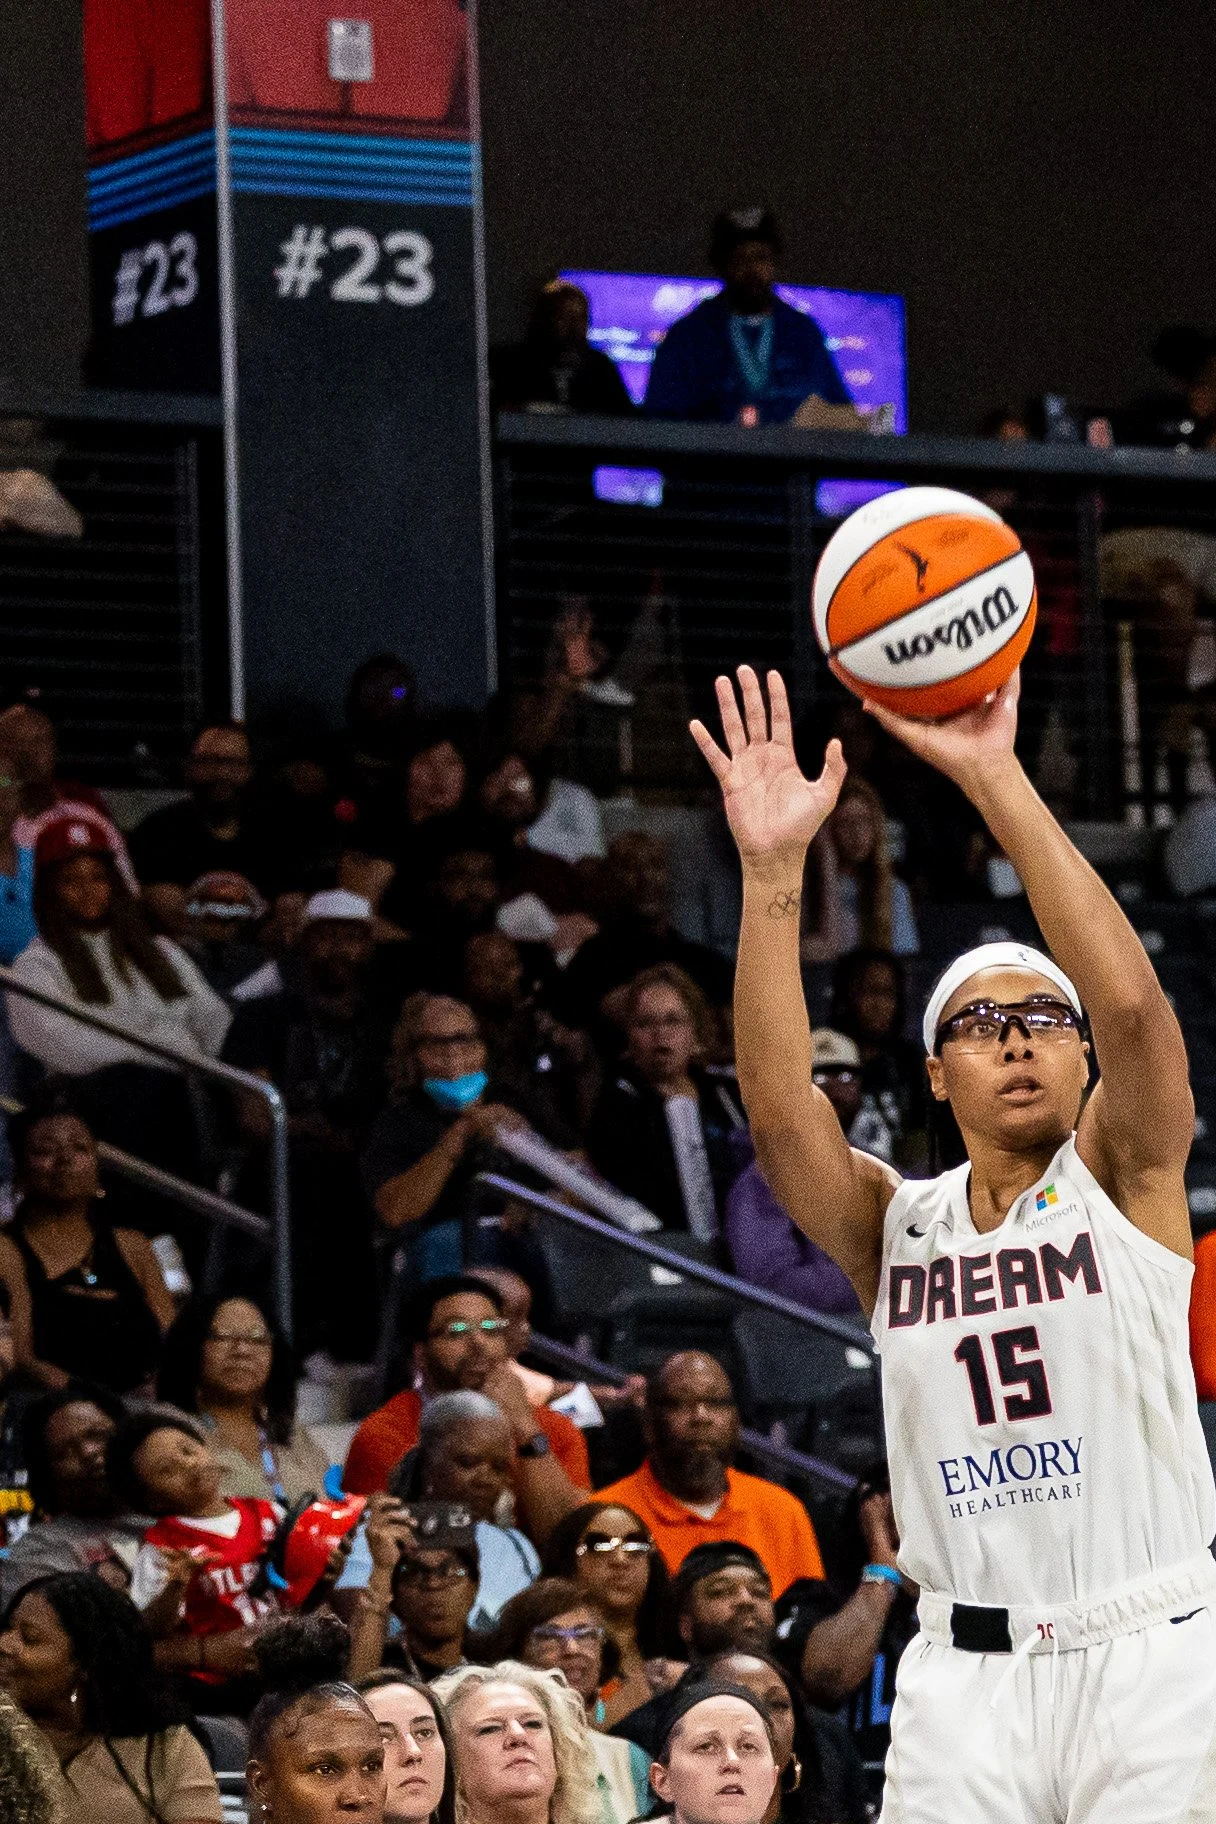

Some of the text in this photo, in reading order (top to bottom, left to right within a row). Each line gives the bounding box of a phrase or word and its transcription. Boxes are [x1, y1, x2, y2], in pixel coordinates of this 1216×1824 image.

[111, 230, 199, 327] #23
[273, 224, 435, 306] #23
[883, 585, 1020, 666] Wilson
[1024, 1202, 1079, 1234] Microsoft
[886, 1231, 1103, 1331] DREAM
[953, 1324, 1053, 1427] 15
[937, 1436, 1083, 1497] EMORY
[949, 1482, 1082, 1519] HEALTHCARE
